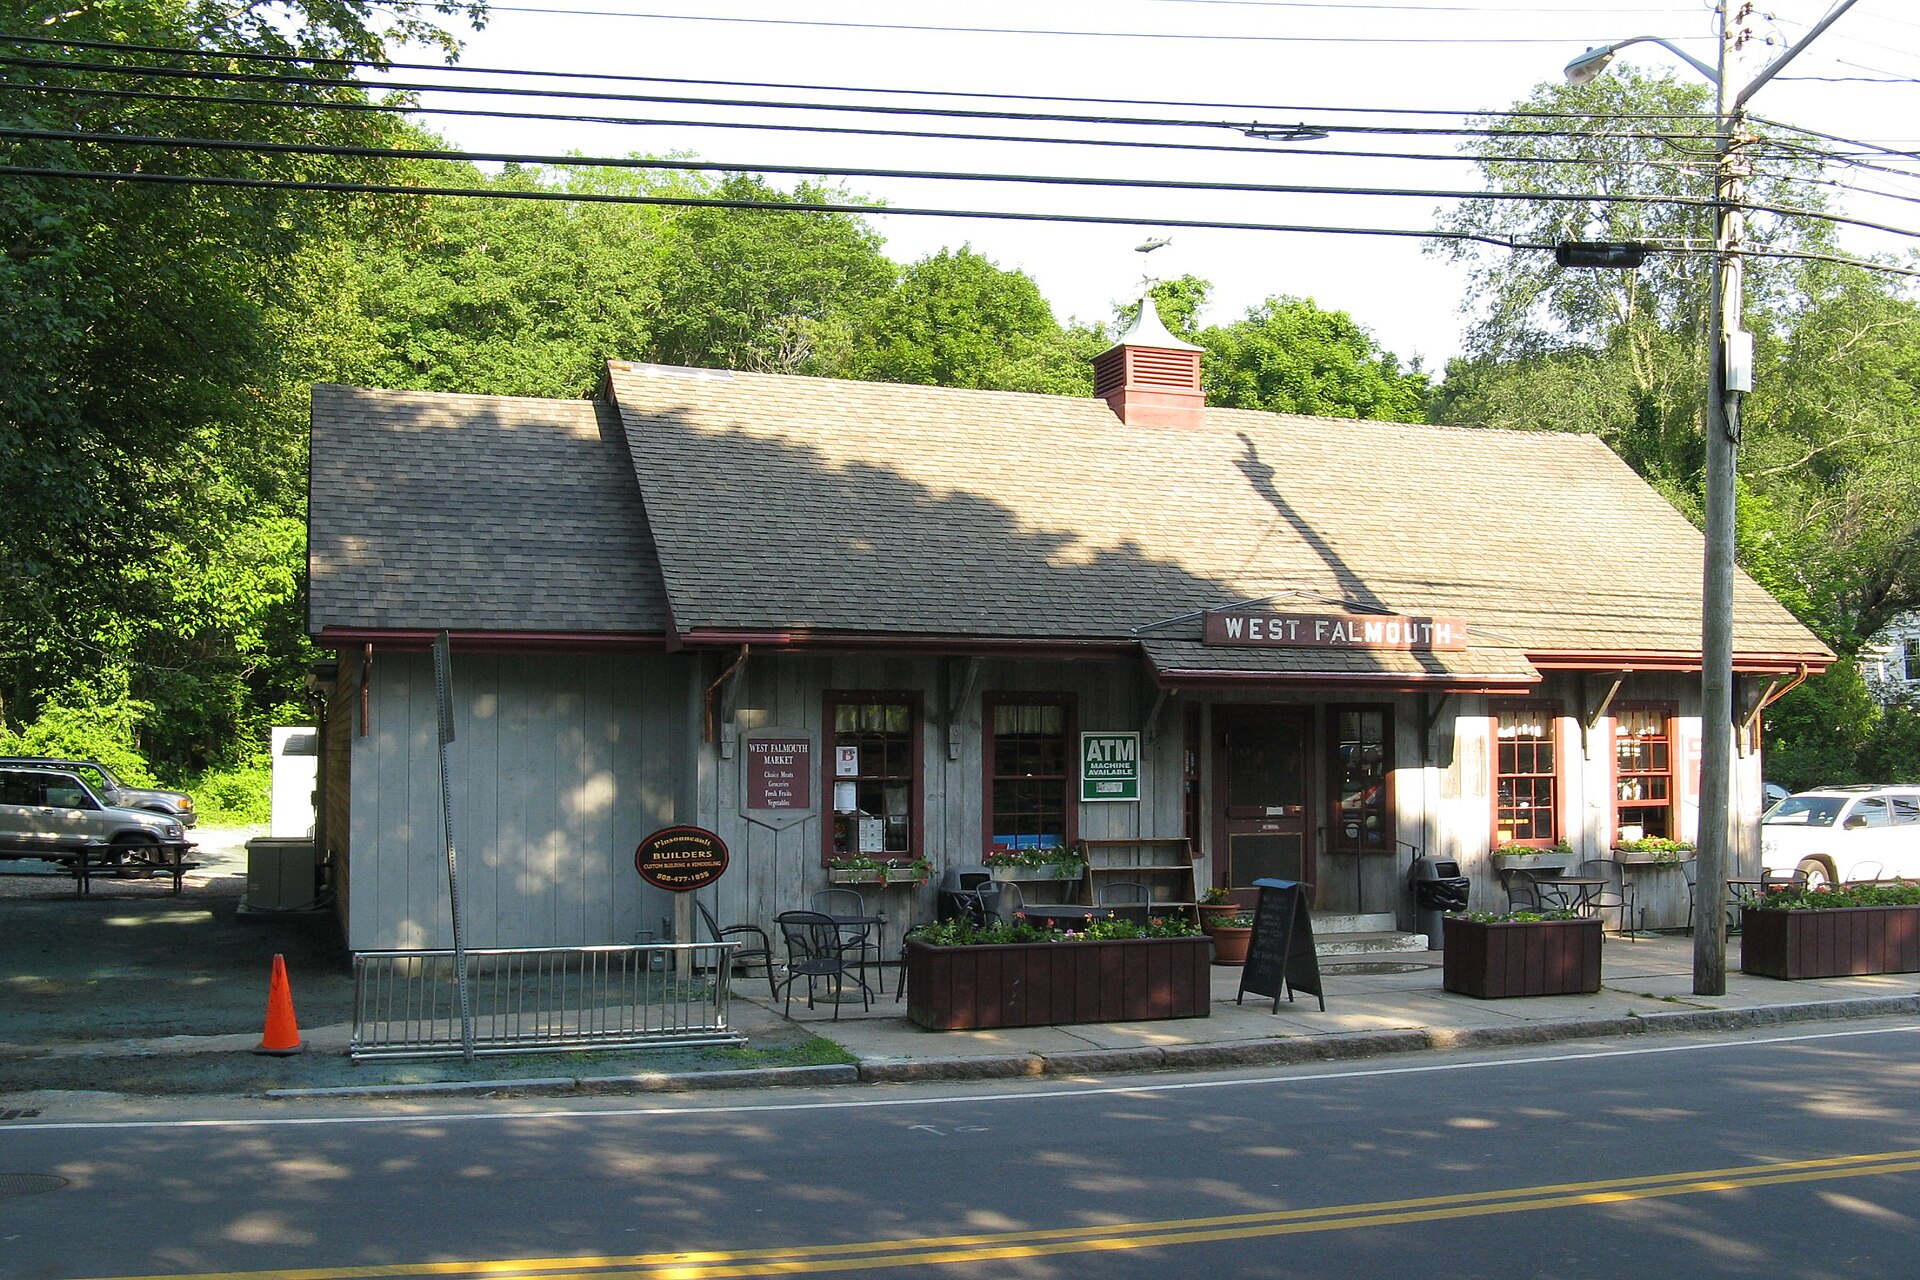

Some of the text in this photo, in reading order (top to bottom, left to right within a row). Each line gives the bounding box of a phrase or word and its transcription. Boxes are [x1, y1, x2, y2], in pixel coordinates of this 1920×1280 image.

[1225, 617, 1451, 644] WEST FALMOUTH
[749, 744, 808, 752] WEST FALMOUTH
[1086, 739, 1135, 762] ATM
[764, 756, 793, 764] MARKET
[768, 780, 789, 788] Groceries
[767, 799, 790, 808] Vegetables
[653, 851, 712, 859] BUILDERS
